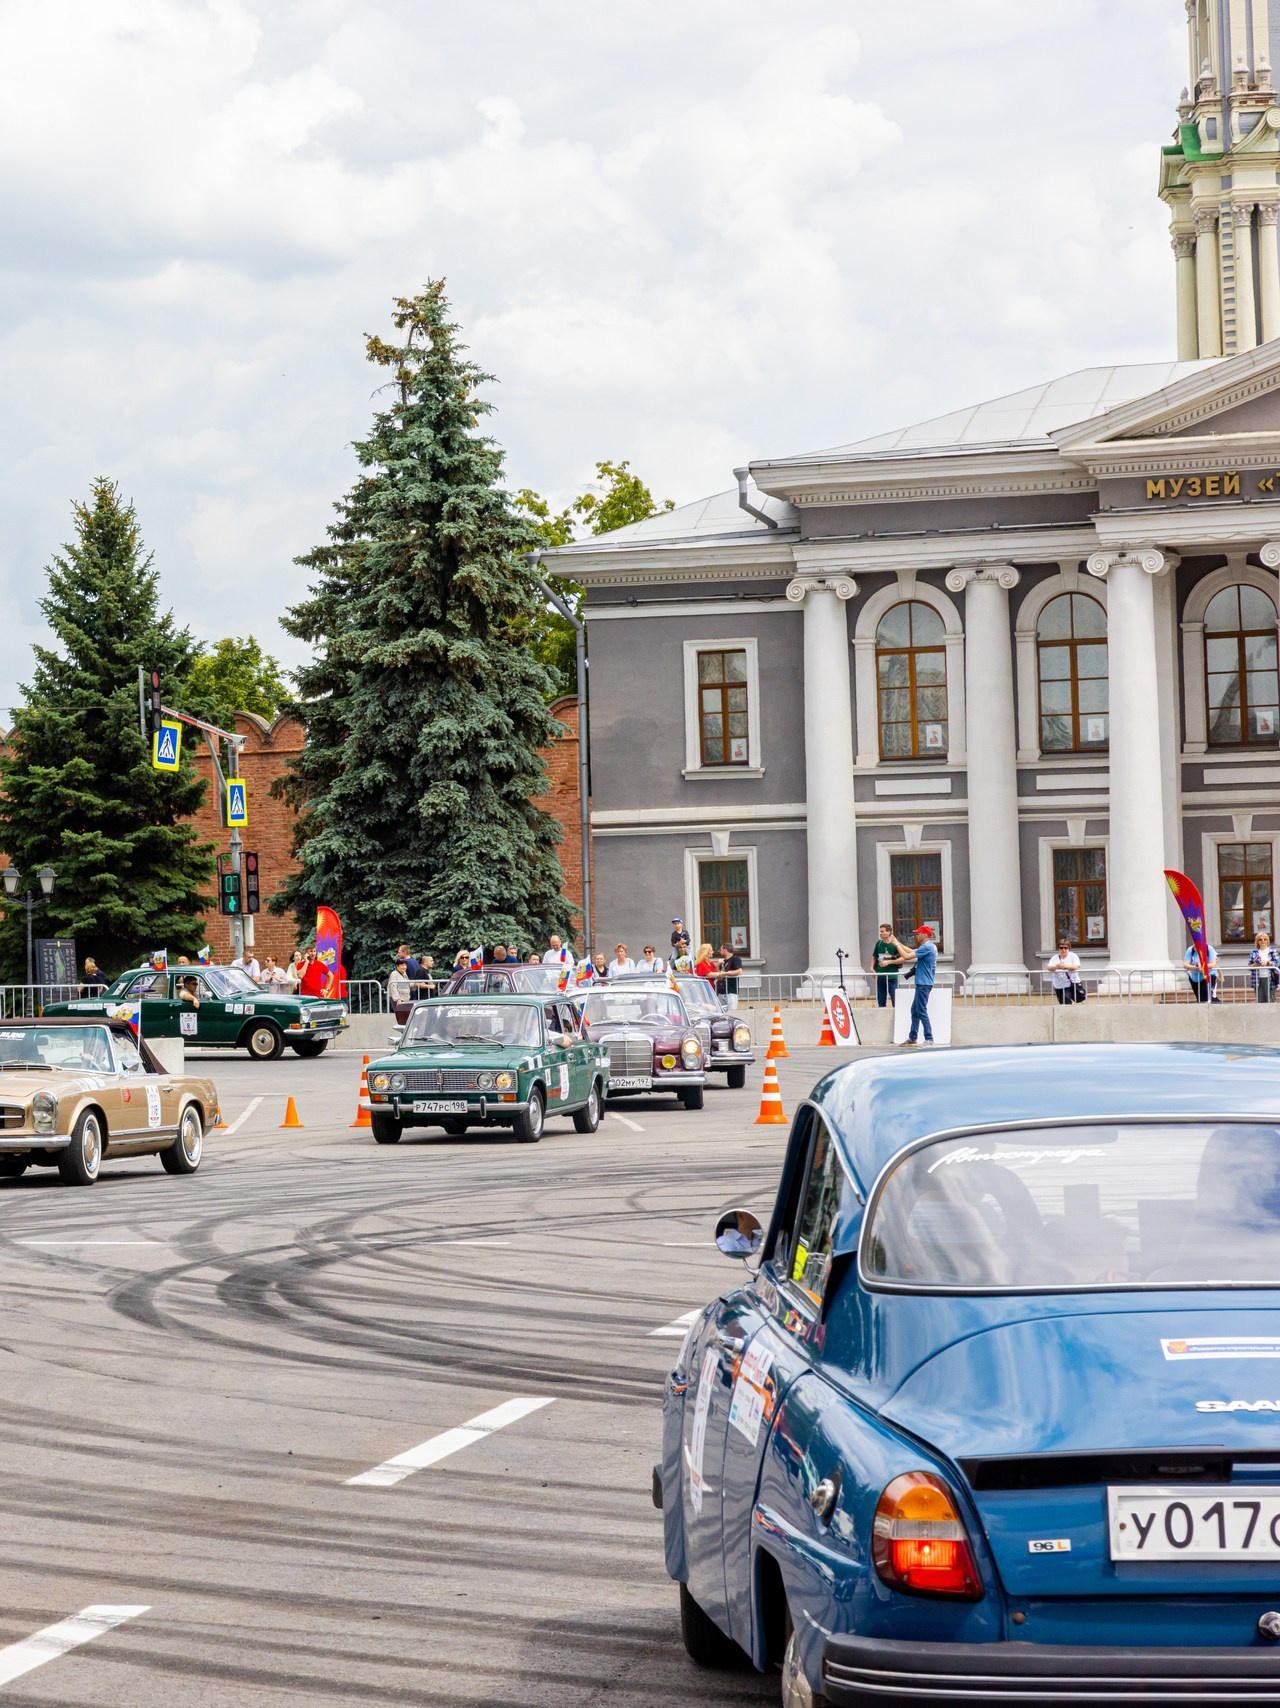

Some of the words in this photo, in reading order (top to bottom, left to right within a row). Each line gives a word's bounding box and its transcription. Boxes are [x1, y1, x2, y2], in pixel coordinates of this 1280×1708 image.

[1146, 470, 1240, 498] МУЗЕЙ
[610, 1078, 636, 1087] 02МУ
[415, 1102, 450, 1112] Р747РС
[451, 1101, 465, 1110] 198
[927, 1147, 1107, 1174] Автострада
[1195, 1400, 1280, 1413] SAA
[1033, 1541, 1054, 1551] 96
[1058, 1542, 1067, 1550] L
